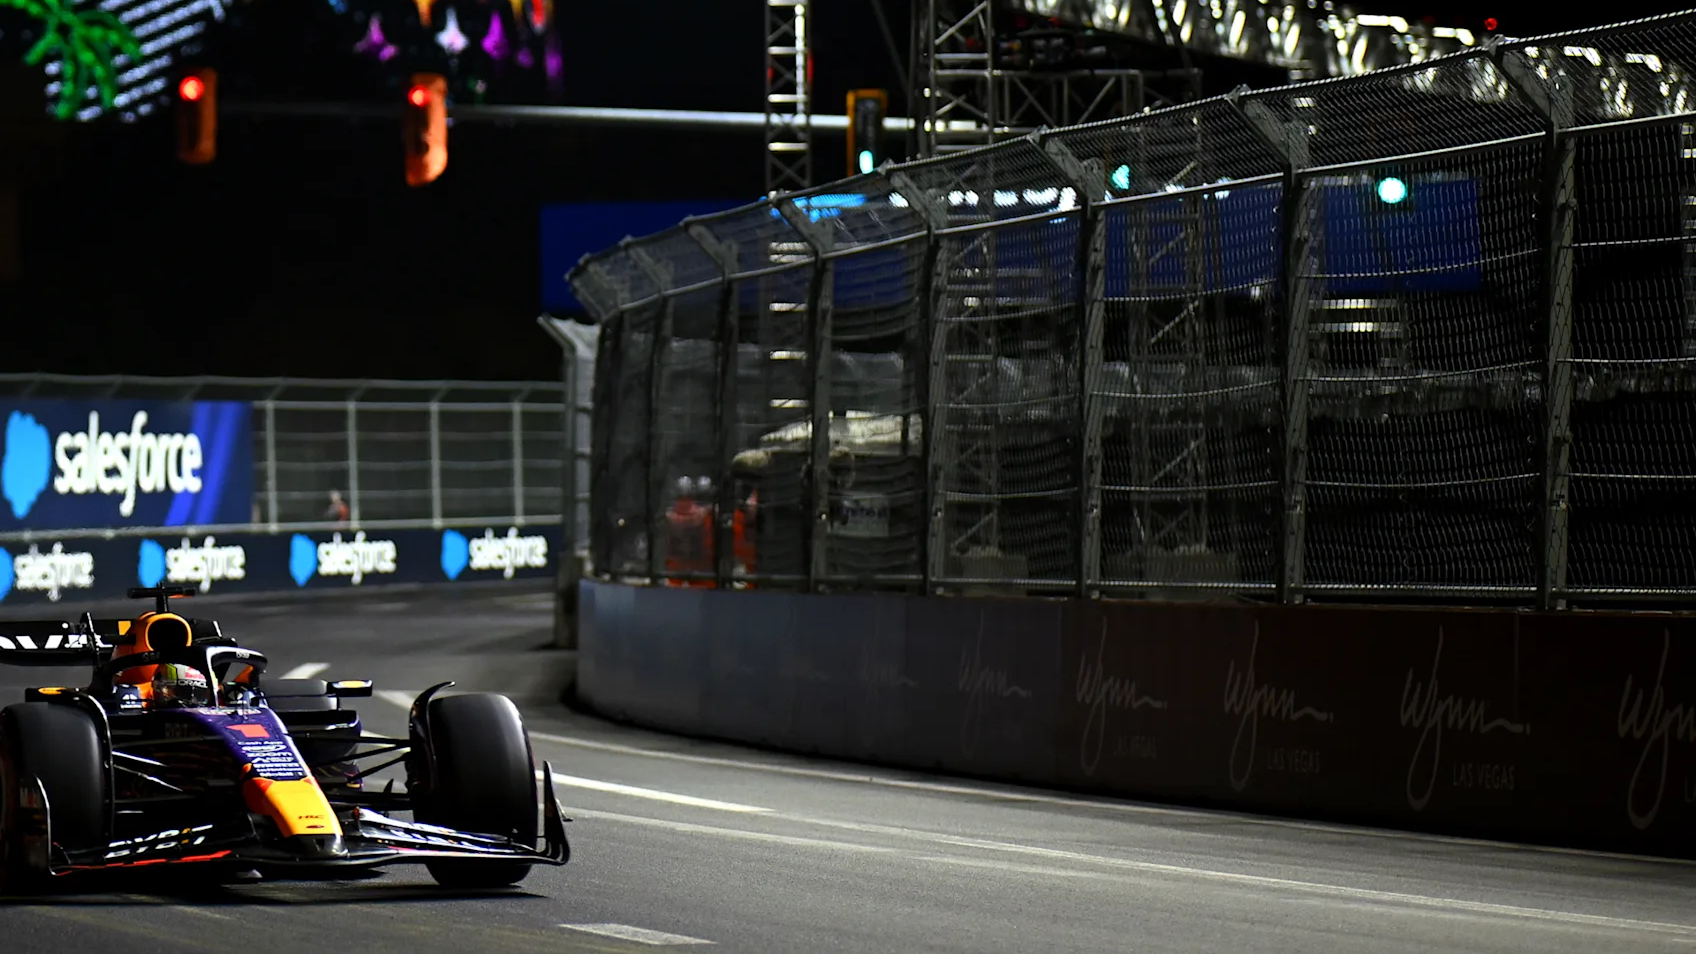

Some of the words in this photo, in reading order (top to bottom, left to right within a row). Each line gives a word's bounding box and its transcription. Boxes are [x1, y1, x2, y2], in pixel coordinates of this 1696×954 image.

[53, 410, 203, 517] salesforce
[14, 542, 95, 600] salesforce
[166, 535, 246, 593] salesforce
[317, 530, 397, 585] salesforce
[469, 527, 548, 579] salesforce
[1266, 749, 1284, 770] LAS
[1288, 750, 1322, 774] VEGAS
[1452, 761, 1474, 788] LAS
[1477, 763, 1515, 791] VEGAS
